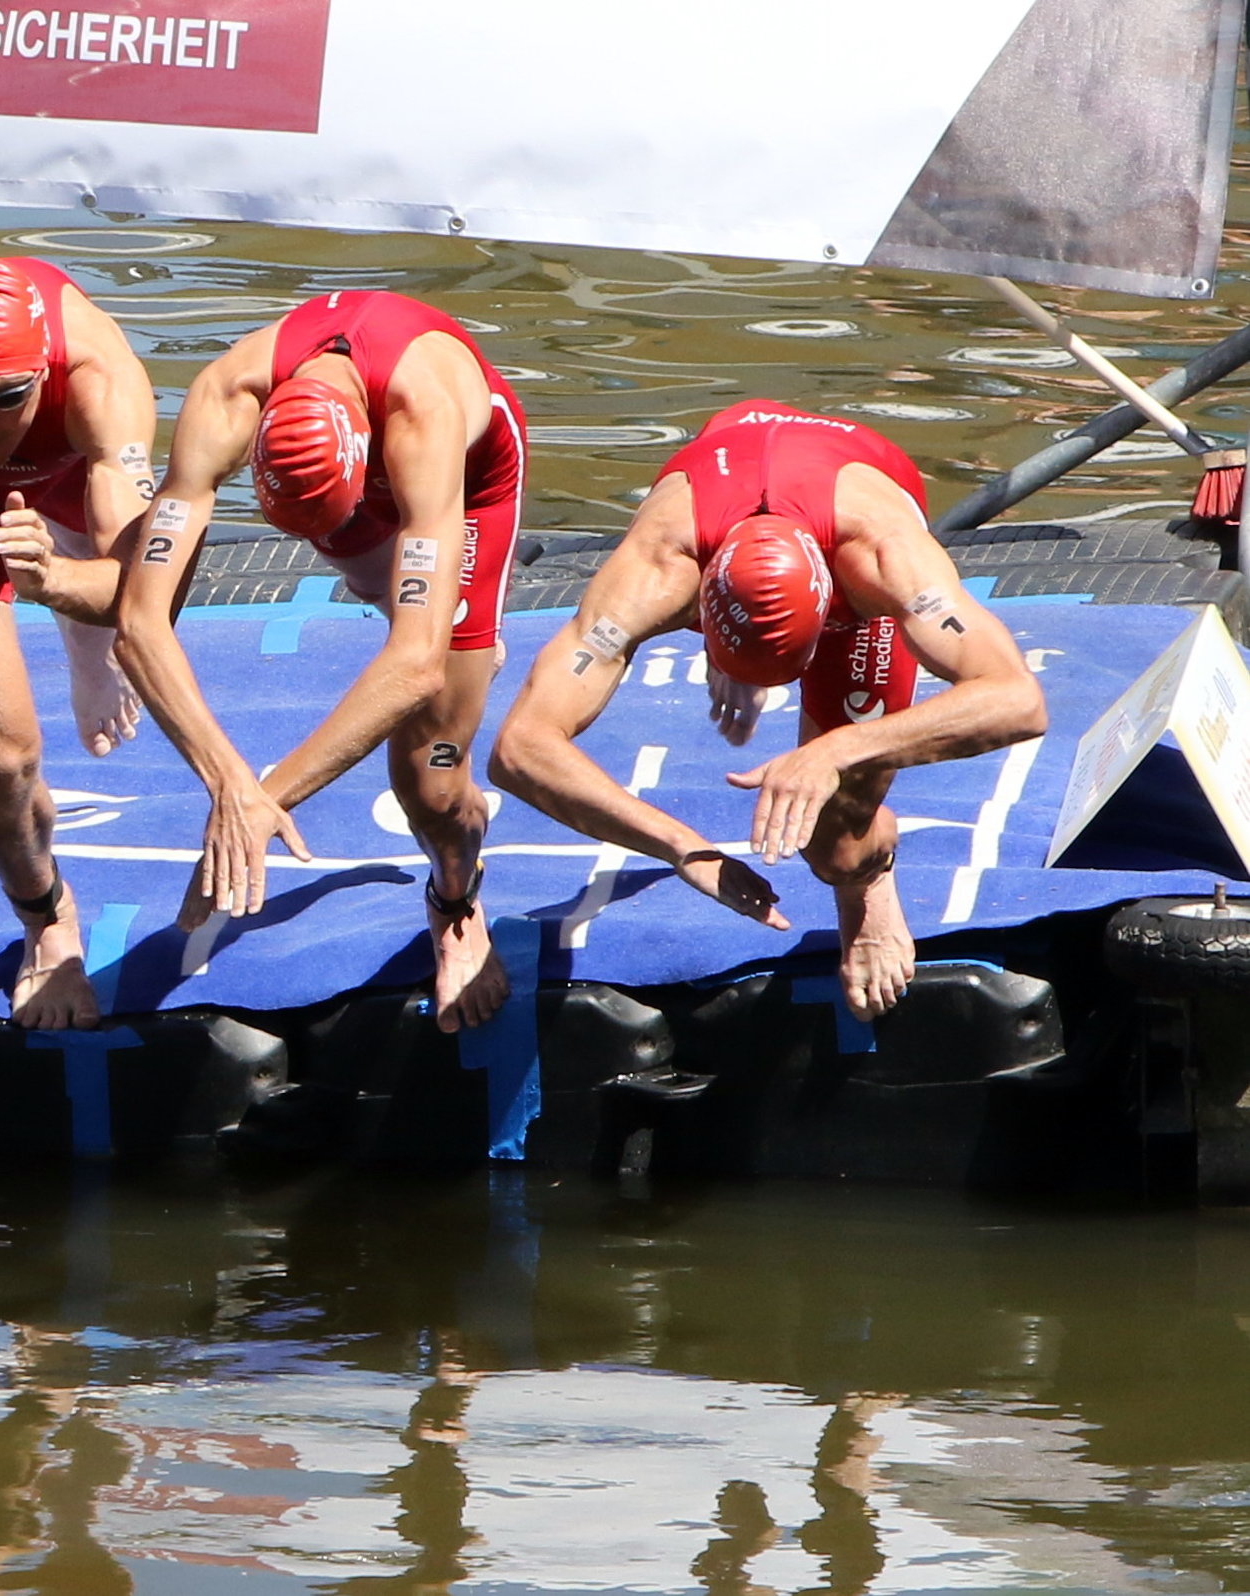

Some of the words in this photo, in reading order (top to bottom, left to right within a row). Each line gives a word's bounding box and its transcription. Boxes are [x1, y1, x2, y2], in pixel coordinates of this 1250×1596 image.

[737, 411, 857, 432] MURRAY
[135, 479, 156, 501] 3
[143, 537, 173, 563] 2
[398, 578, 428, 606] 2
[940, 615, 966, 635] 1
[572, 650, 595, 676] 1
[872, 616, 895, 685] medien
[428, 742, 460, 769] 2
